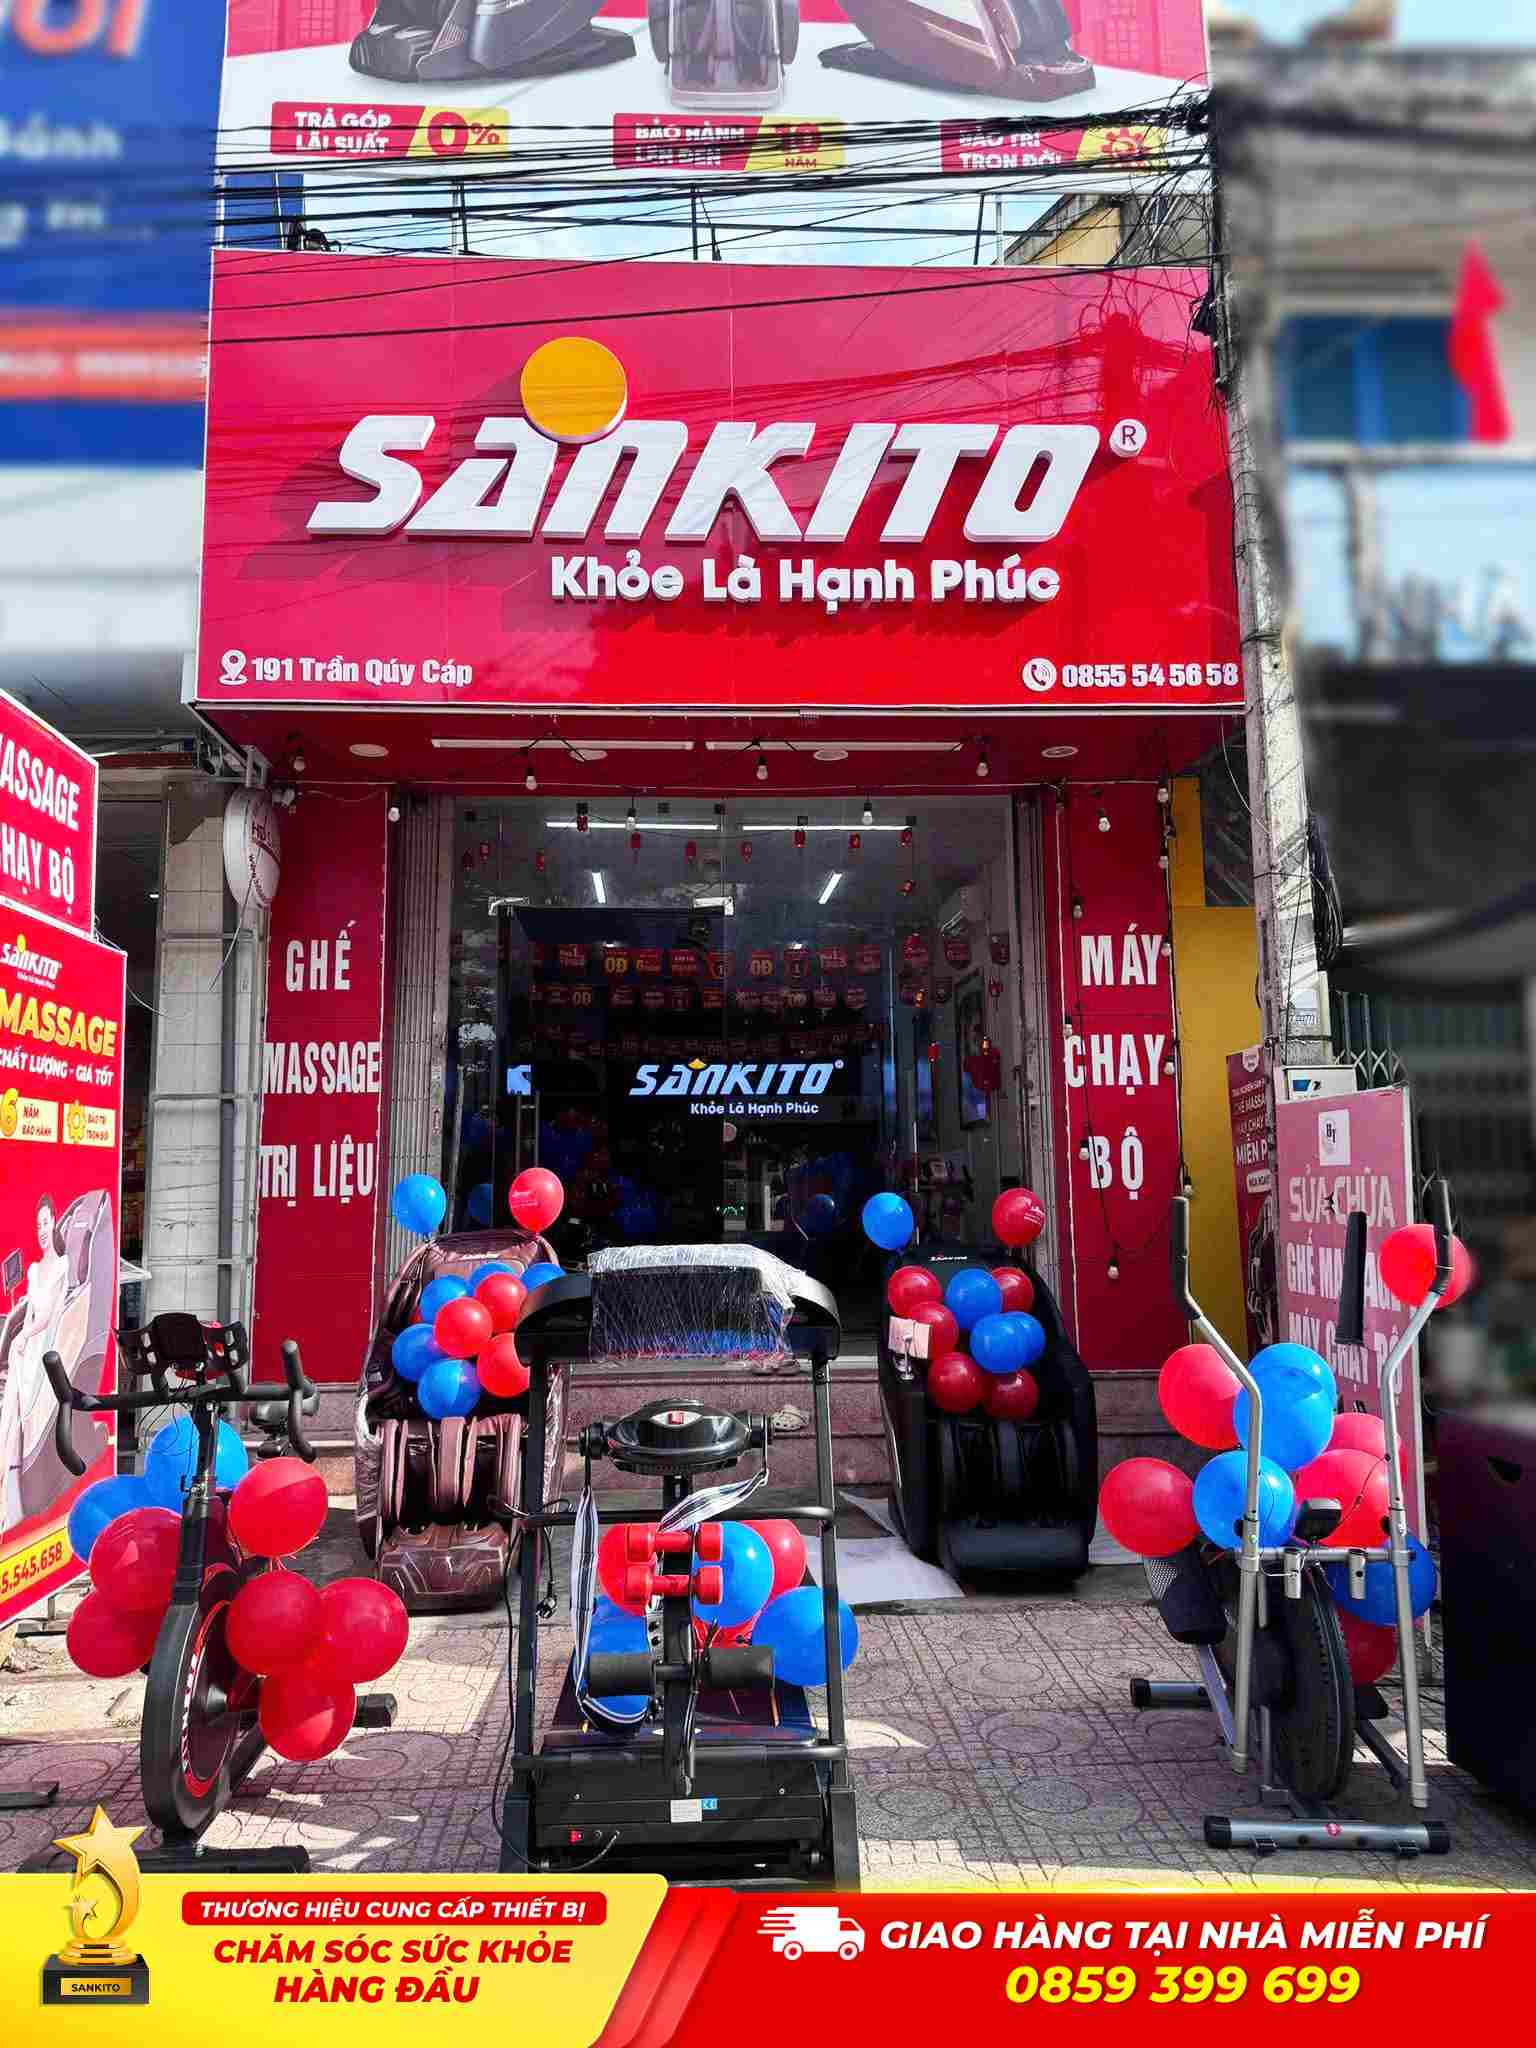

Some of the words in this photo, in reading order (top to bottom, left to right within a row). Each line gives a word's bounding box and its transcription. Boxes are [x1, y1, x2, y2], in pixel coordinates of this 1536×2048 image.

[294, 107, 337, 129] TRẢ
[341, 110, 391, 129] GÓP
[428, 111, 501, 155] 0%
[551, 549, 684, 600] Khỏe
[703, 554, 762, 600] Là
[780, 558, 914, 615] Hạnh
[931, 553, 1061, 602] Phúc
[252, 658, 294, 682] 191
[299, 655, 360, 682] Trần
[422, 659, 473, 687] Cáp
[1062, 664, 1127, 688] 0855
[1131, 664, 1166, 687] 54
[1169, 663, 1202, 687] 56
[1206, 663, 1239, 686] 58
[0, 733, 81, 831] ASSAGE
[49, 847, 75, 915] BỘ
[286, 920, 357, 992] GHẾ
[1081, 922, 1163, 986] MÁY
[0, 987, 118, 1057] MASSAGE
[263, 1041, 382, 1095] MASSAGE
[1065, 1034, 1166, 1096] CHẠY
[690, 1101, 725, 1115] Khỏe
[748, 1102, 783, 1118] Hạnh
[259, 1145, 297, 1207] TRỊ
[1088, 1126, 1144, 1200] BỘ
